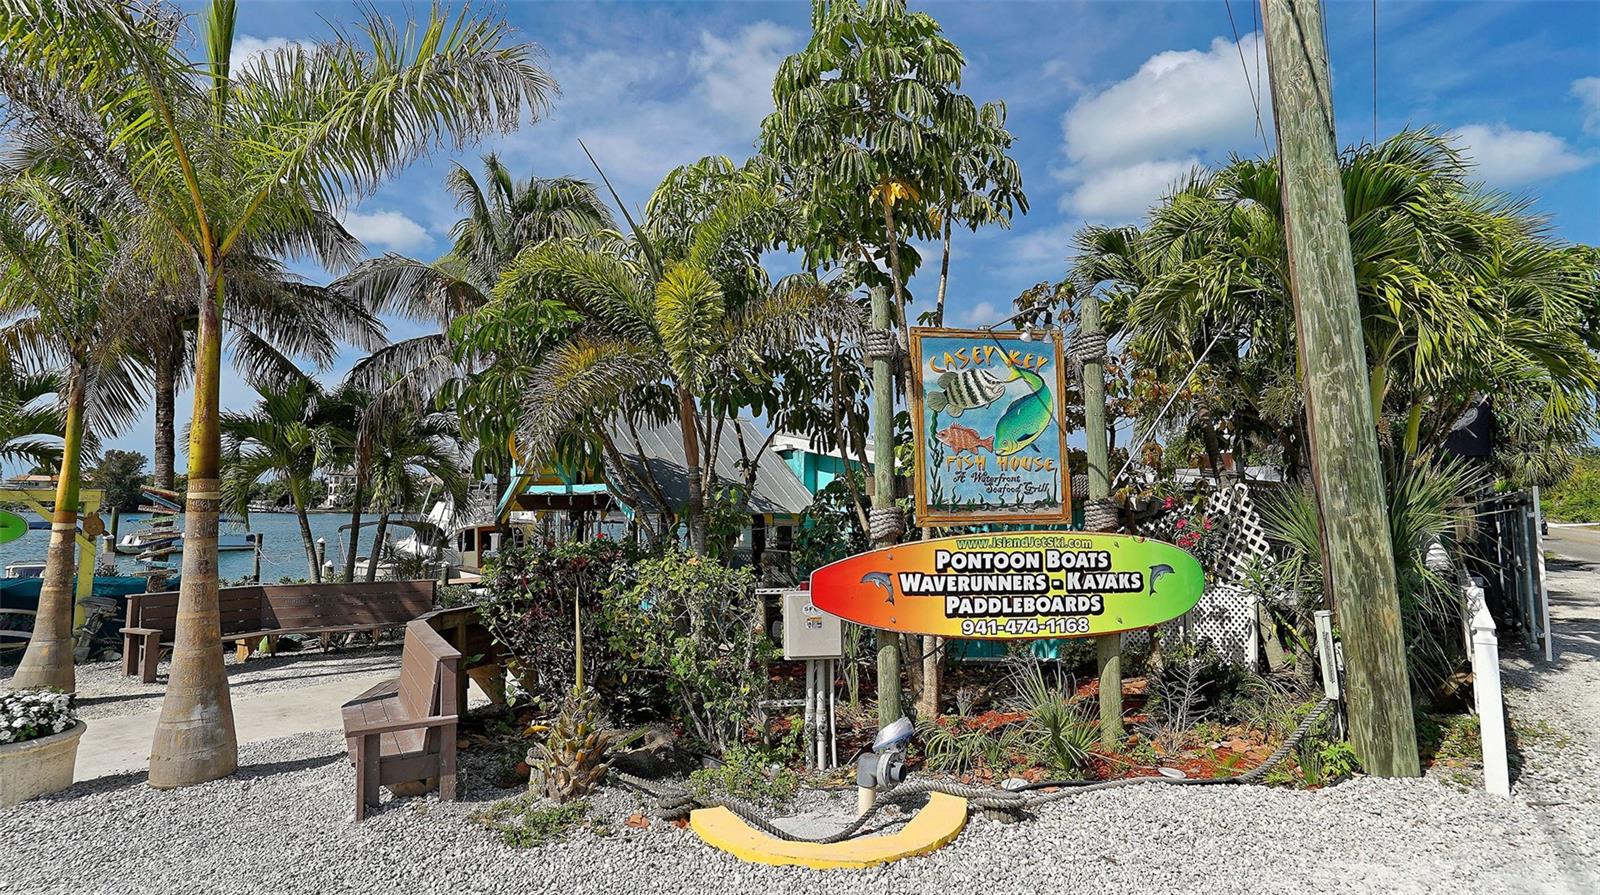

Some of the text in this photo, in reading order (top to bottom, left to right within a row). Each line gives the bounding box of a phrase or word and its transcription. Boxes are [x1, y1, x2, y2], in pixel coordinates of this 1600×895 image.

[929, 345, 1049, 373] CASEY KEY
[946, 455, 1055, 472] FISH HOUSE
[953, 471, 1021, 486] A Waterfront
[985, 481, 1049, 495] Seafood Grill
[956, 536, 1093, 550] www.IslandJetSki.com
[935, 549, 1110, 572] PONTOON BOATS
[898, 573, 1048, 594] WAVERUNNERS
[1066, 571, 1142, 592] KAYAKS
[945, 595, 1103, 616] PADDLEBOARDS
[961, 617, 1090, 635] 941-474-1168
